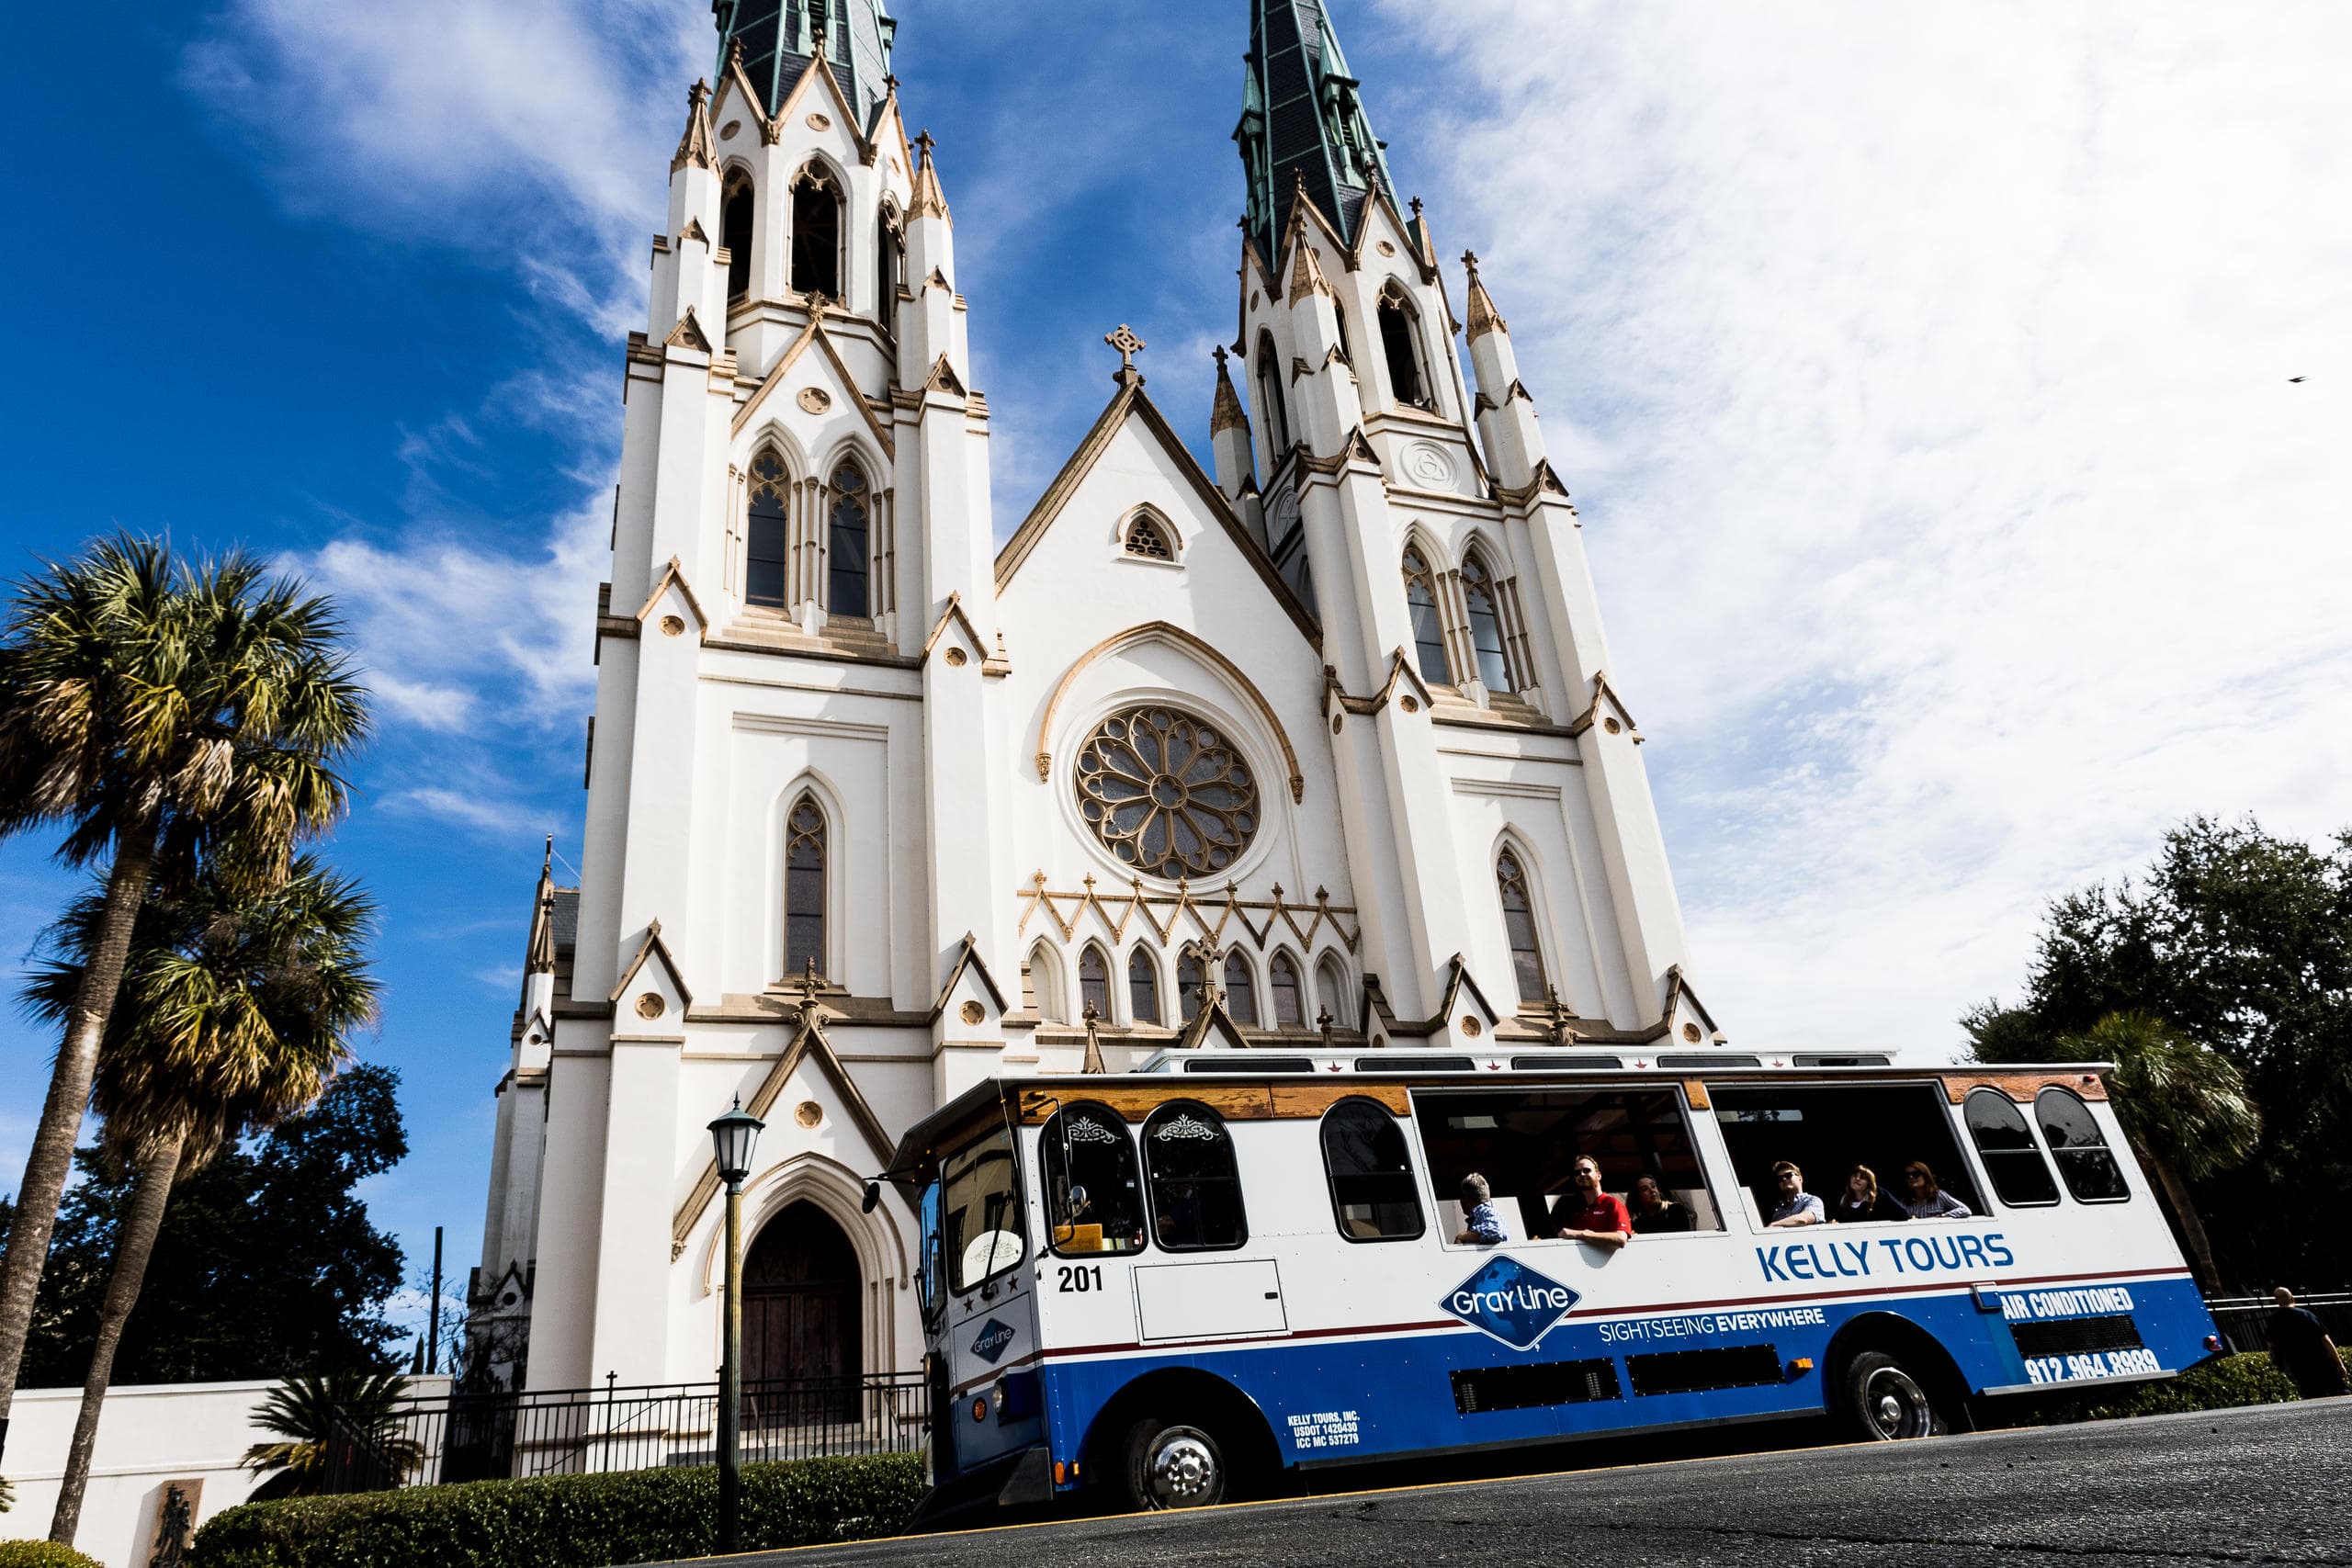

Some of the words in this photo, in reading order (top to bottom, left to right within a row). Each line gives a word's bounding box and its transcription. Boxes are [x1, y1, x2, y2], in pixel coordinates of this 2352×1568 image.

[1755, 1241, 1871, 1282] KELLY
[1879, 1234, 2014, 1273] TOURS
[1057, 1265, 1102, 1292] 201
[1453, 1290, 1514, 1314] Gray
[1516, 1285, 1568, 1310] Line
[1999, 1293, 2032, 1320] AIR
[2029, 1287, 2134, 1318] CONDITIONED
[1599, 1316, 1714, 1342] SIGHTSEEING
[1715, 1308, 1826, 1332] EVERYWHERE
[974, 1336, 995, 1353] Gray
[2024, 1348, 2161, 1385] 912.964.8989
[1287, 1415, 1310, 1427] KELLY
[1312, 1412, 1342, 1425] TOURS,
[1342, 1410, 1360, 1422] INC.
[1294, 1425, 1320, 1438] USDOT
[1323, 1422, 1358, 1435] 1420430
[1295, 1438, 1311, 1449] ICC
[1313, 1436, 1327, 1448] MC
[1328, 1433, 1359, 1446] 537279
